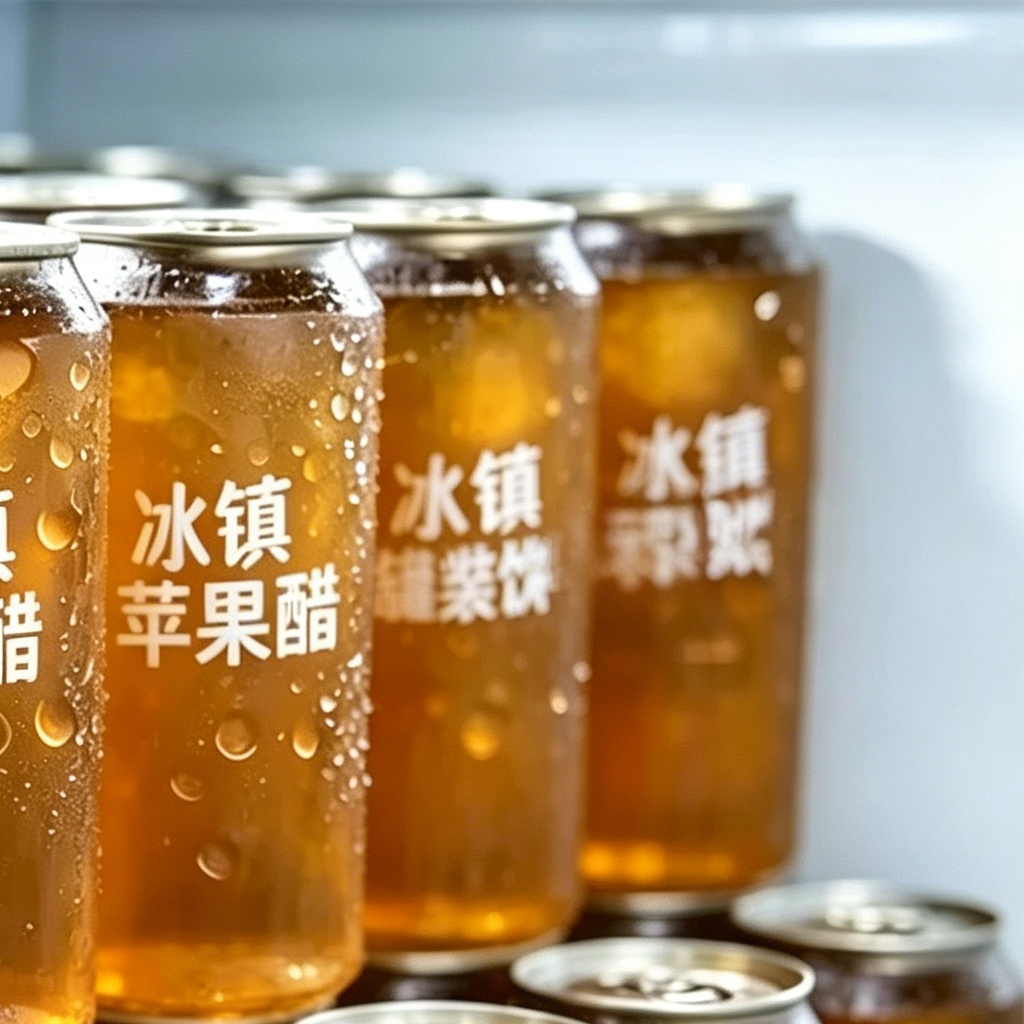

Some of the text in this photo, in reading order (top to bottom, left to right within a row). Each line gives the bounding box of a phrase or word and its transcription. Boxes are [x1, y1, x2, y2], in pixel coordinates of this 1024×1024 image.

[132, 474, 293, 572] 冰镇
[390, 441, 543, 542] 冰镇
[117, 563, 341, 668] 苹果醋
